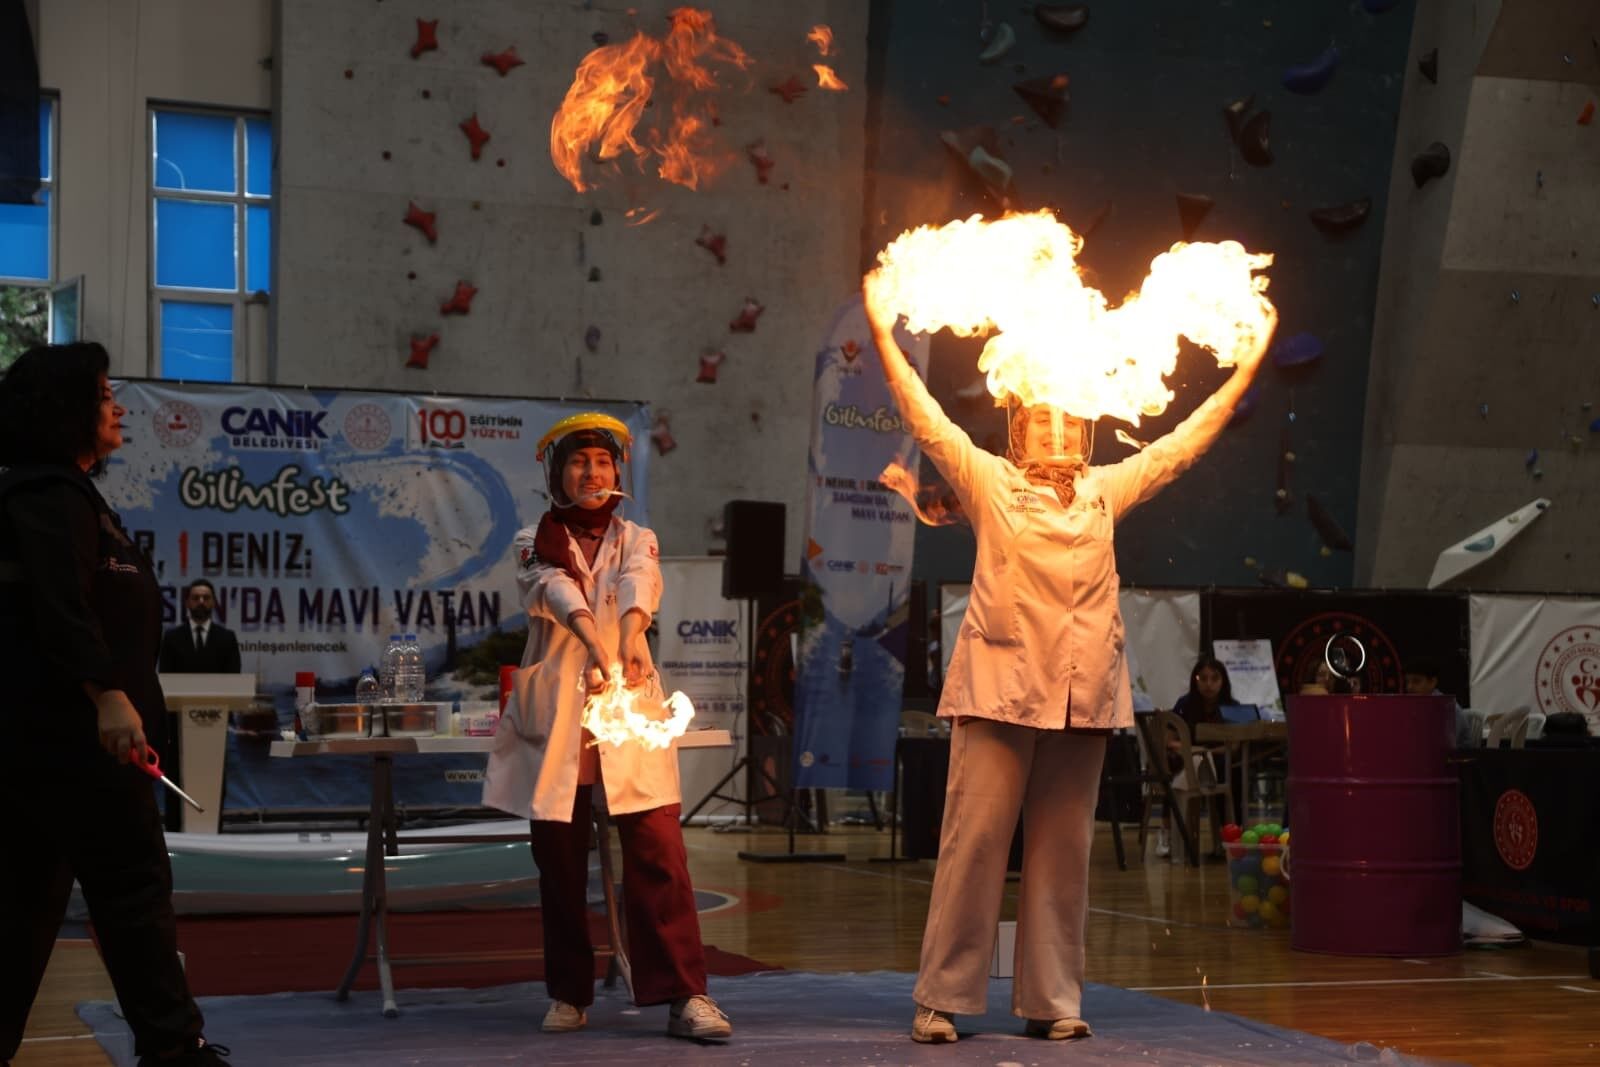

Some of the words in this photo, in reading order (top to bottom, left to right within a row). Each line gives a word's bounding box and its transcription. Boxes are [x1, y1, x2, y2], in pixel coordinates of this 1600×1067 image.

[469, 414, 523, 428] EĞİTİMİN
[471, 427, 520, 440] YÜZYILI
[202, 529, 313, 572] DENİZ:
[299, 585, 380, 626] MAVİ
[393, 589, 500, 627] VATAN
